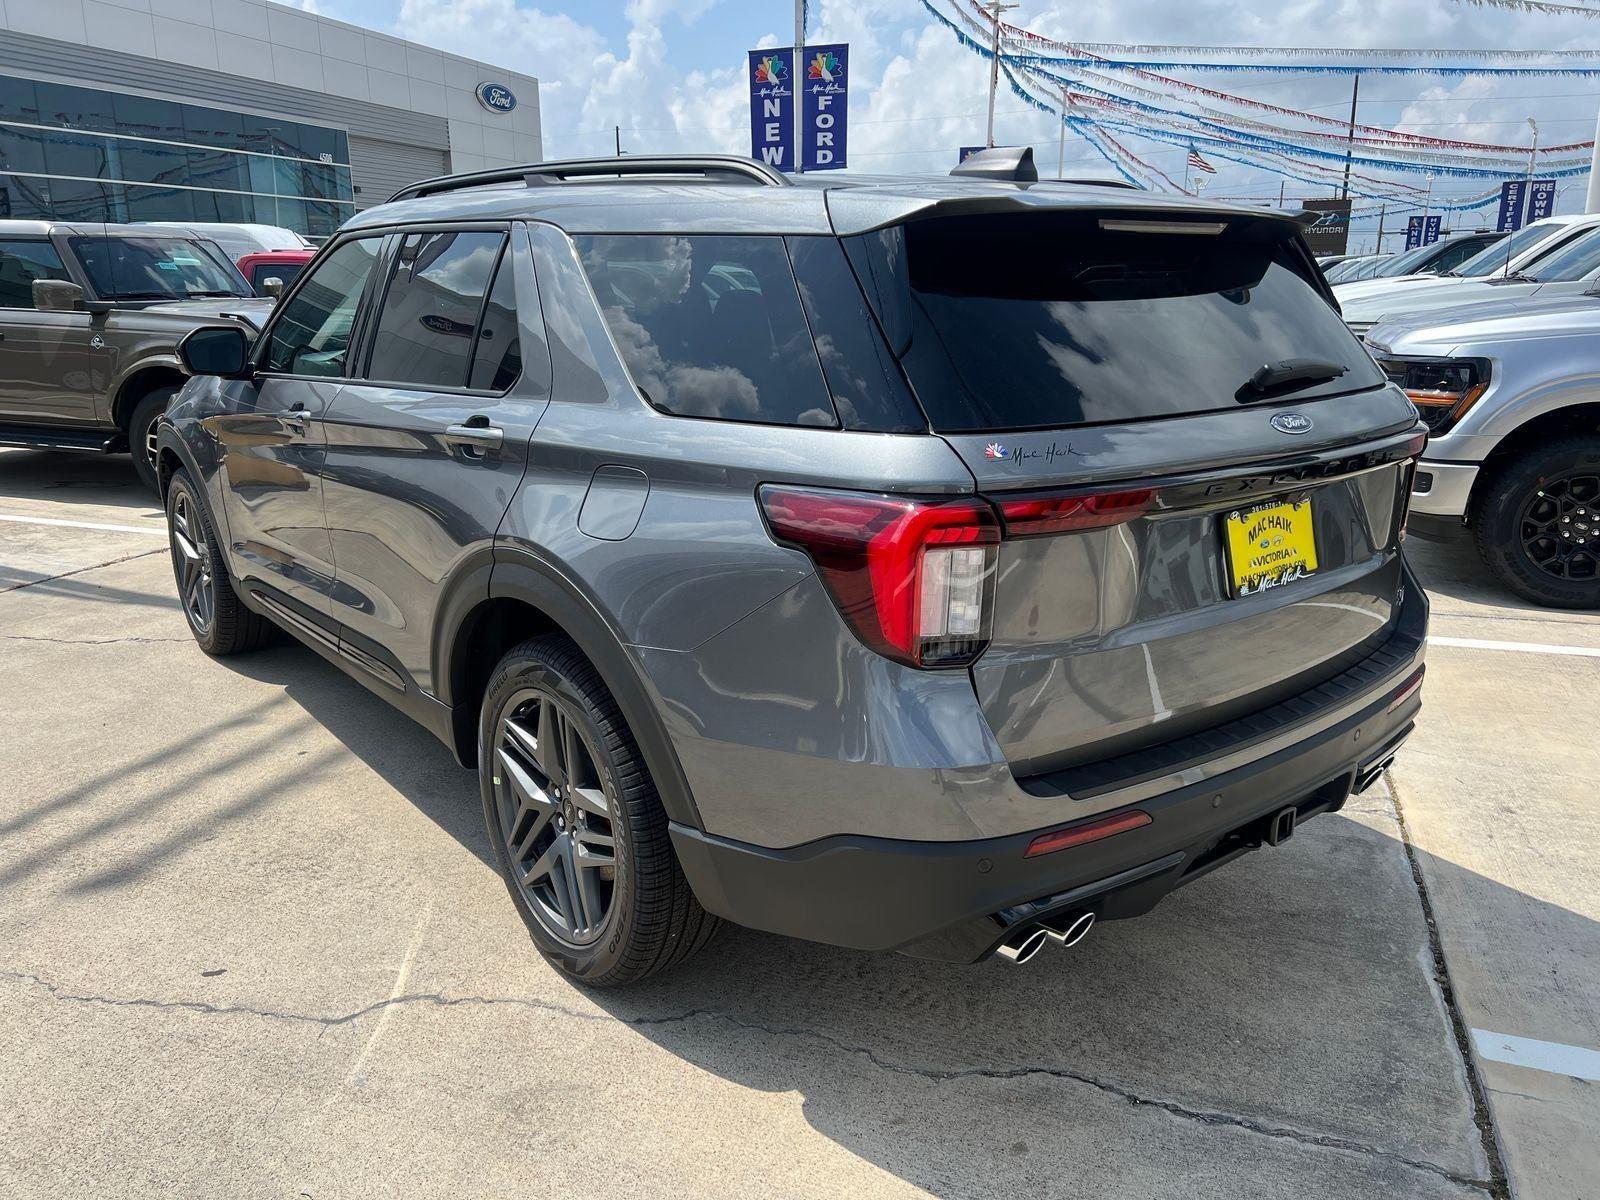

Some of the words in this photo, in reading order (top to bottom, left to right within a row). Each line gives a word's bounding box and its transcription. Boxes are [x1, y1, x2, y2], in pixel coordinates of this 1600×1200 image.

[490, 88, 511, 108] Ford
[761, 98, 784, 165] NEW
[815, 95, 835, 164] FORD
[1532, 183, 1554, 191] PRE
[1503, 183, 1519, 233] CERTIFIED
[1304, 226, 1344, 234] HYUNDAI
[1283, 414, 1307, 427] Ford
[1248, 516, 1267, 545] MAC
[1267, 515, 1293, 534] HAIK
[1255, 574, 1281, 593] Mac
